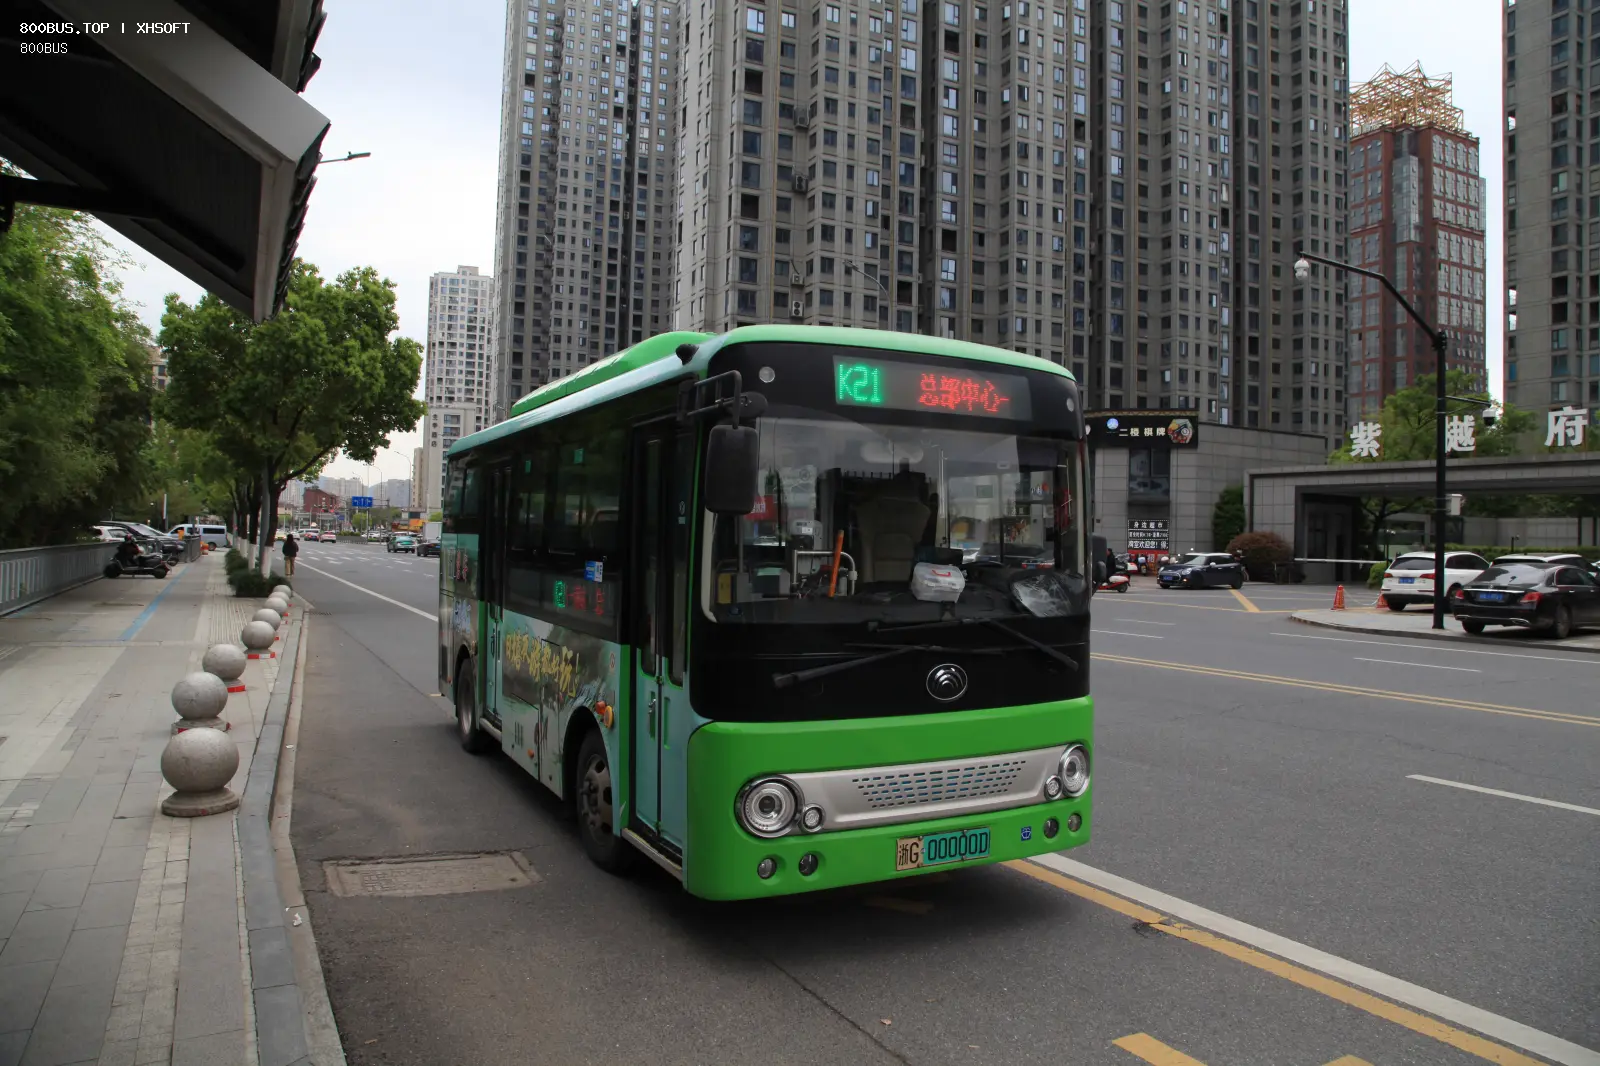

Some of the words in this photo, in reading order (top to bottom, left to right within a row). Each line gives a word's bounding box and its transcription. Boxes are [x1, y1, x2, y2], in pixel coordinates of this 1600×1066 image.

[838, 363, 882, 403] K21
[1118, 427, 1166, 437] 二楼棋牌
